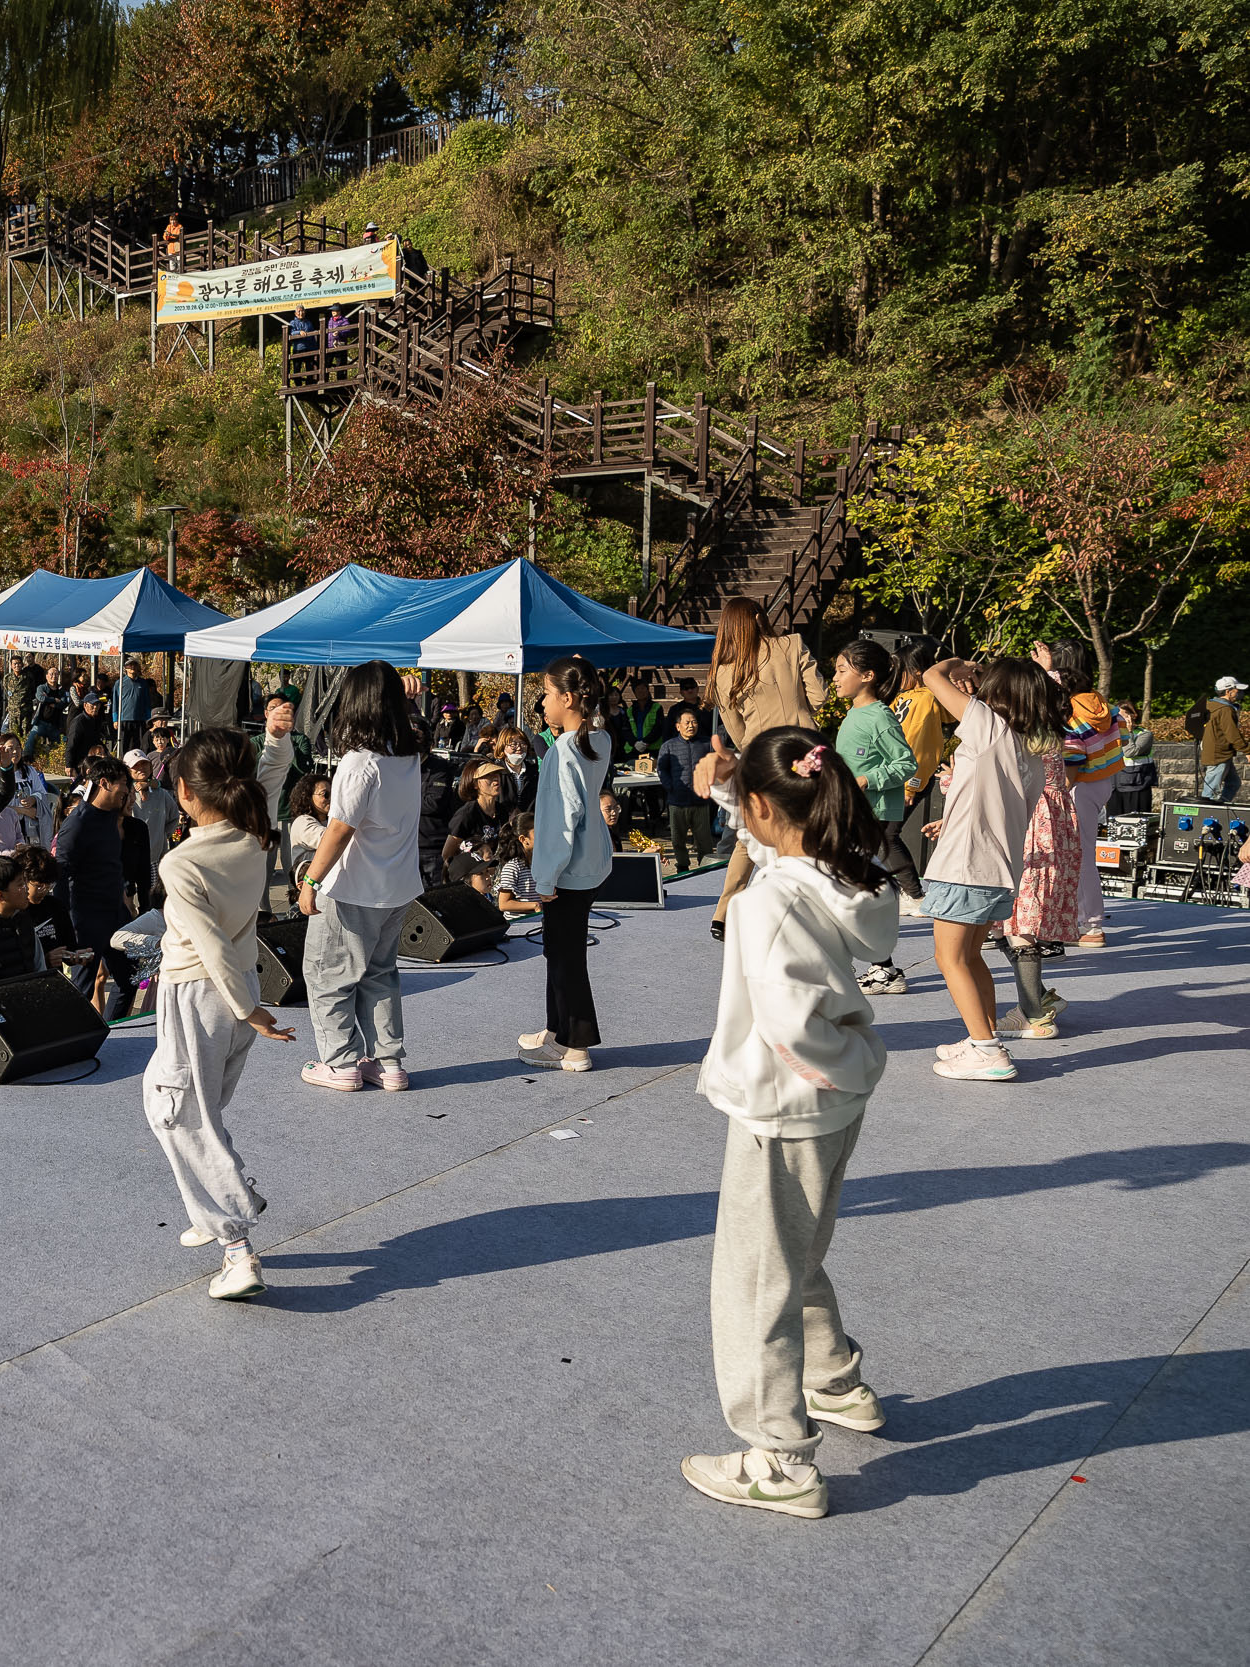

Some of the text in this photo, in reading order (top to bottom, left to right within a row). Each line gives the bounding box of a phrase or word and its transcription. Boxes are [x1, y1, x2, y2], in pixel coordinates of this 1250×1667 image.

[198, 279, 247, 302] 광나루
[254, 269, 306, 293] 해오름
[309, 265, 345, 288] 축제
[23, 635, 69, 651] 재난구조협회
